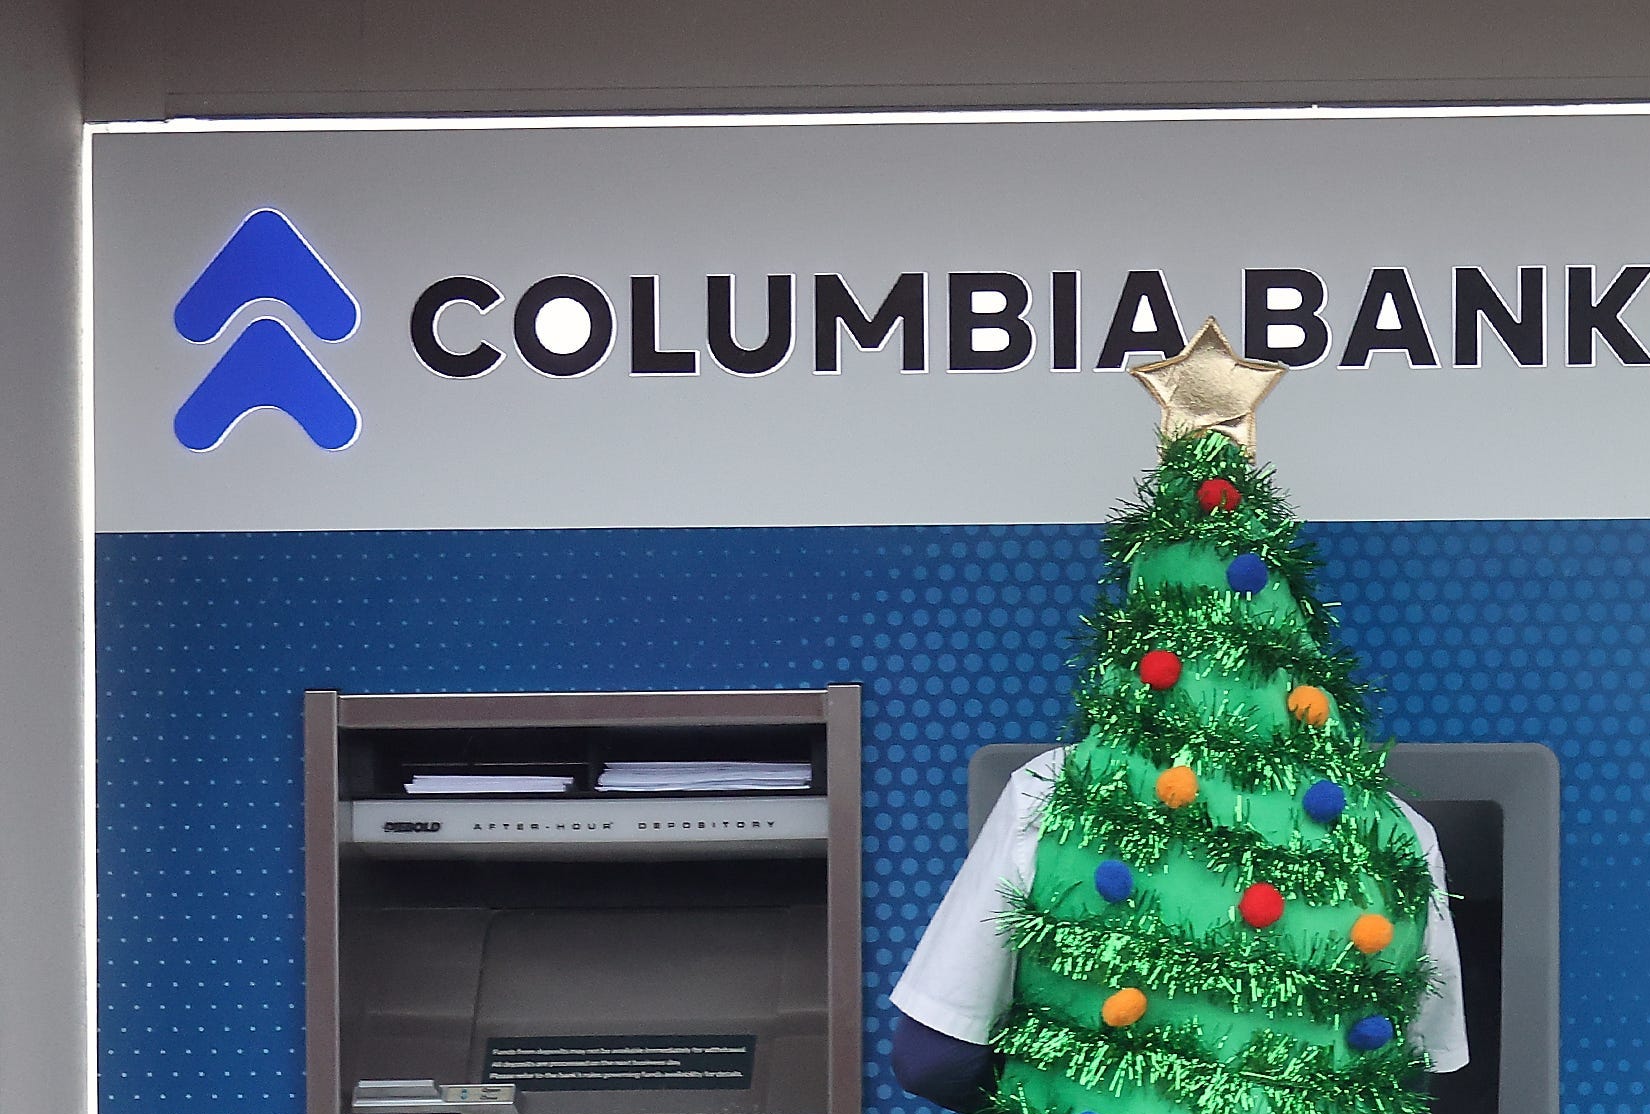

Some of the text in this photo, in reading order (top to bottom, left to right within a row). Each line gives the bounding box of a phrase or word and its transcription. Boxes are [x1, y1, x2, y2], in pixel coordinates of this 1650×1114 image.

[409, 269, 1190, 379] COLUMBIA
[472, 821, 613, 830] AFTER-HOUR
[637, 819, 775, 830] DEPOSITORY
